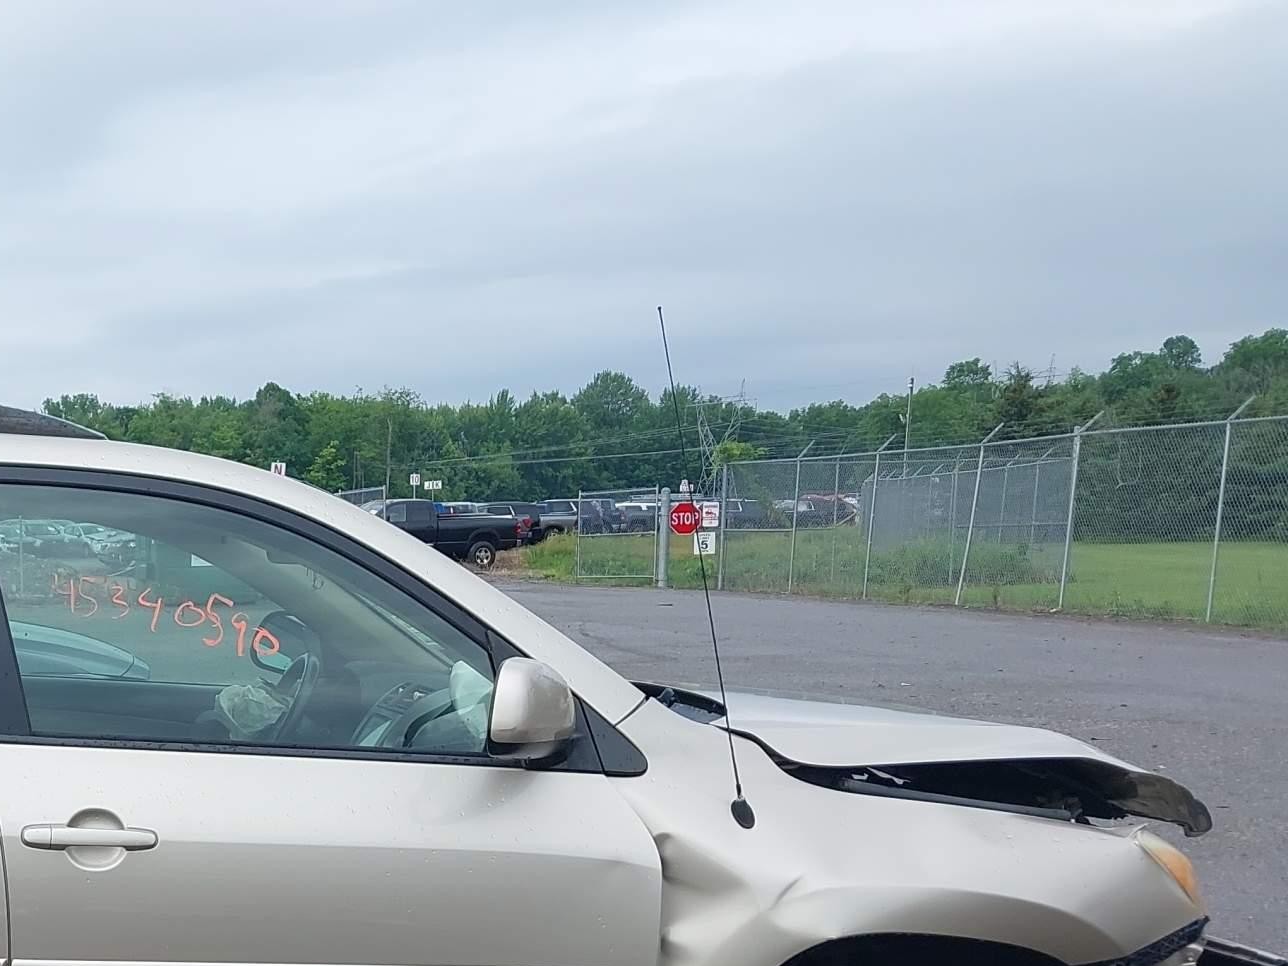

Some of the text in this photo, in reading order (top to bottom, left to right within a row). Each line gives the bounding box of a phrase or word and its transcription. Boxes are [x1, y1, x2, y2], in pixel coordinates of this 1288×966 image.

[274, 464, 283, 475] N
[411, 475, 420, 484] 10
[671, 512, 699, 525] STOP
[700, 540, 709, 550] 5
[53, 574, 280, 657] 45340590
